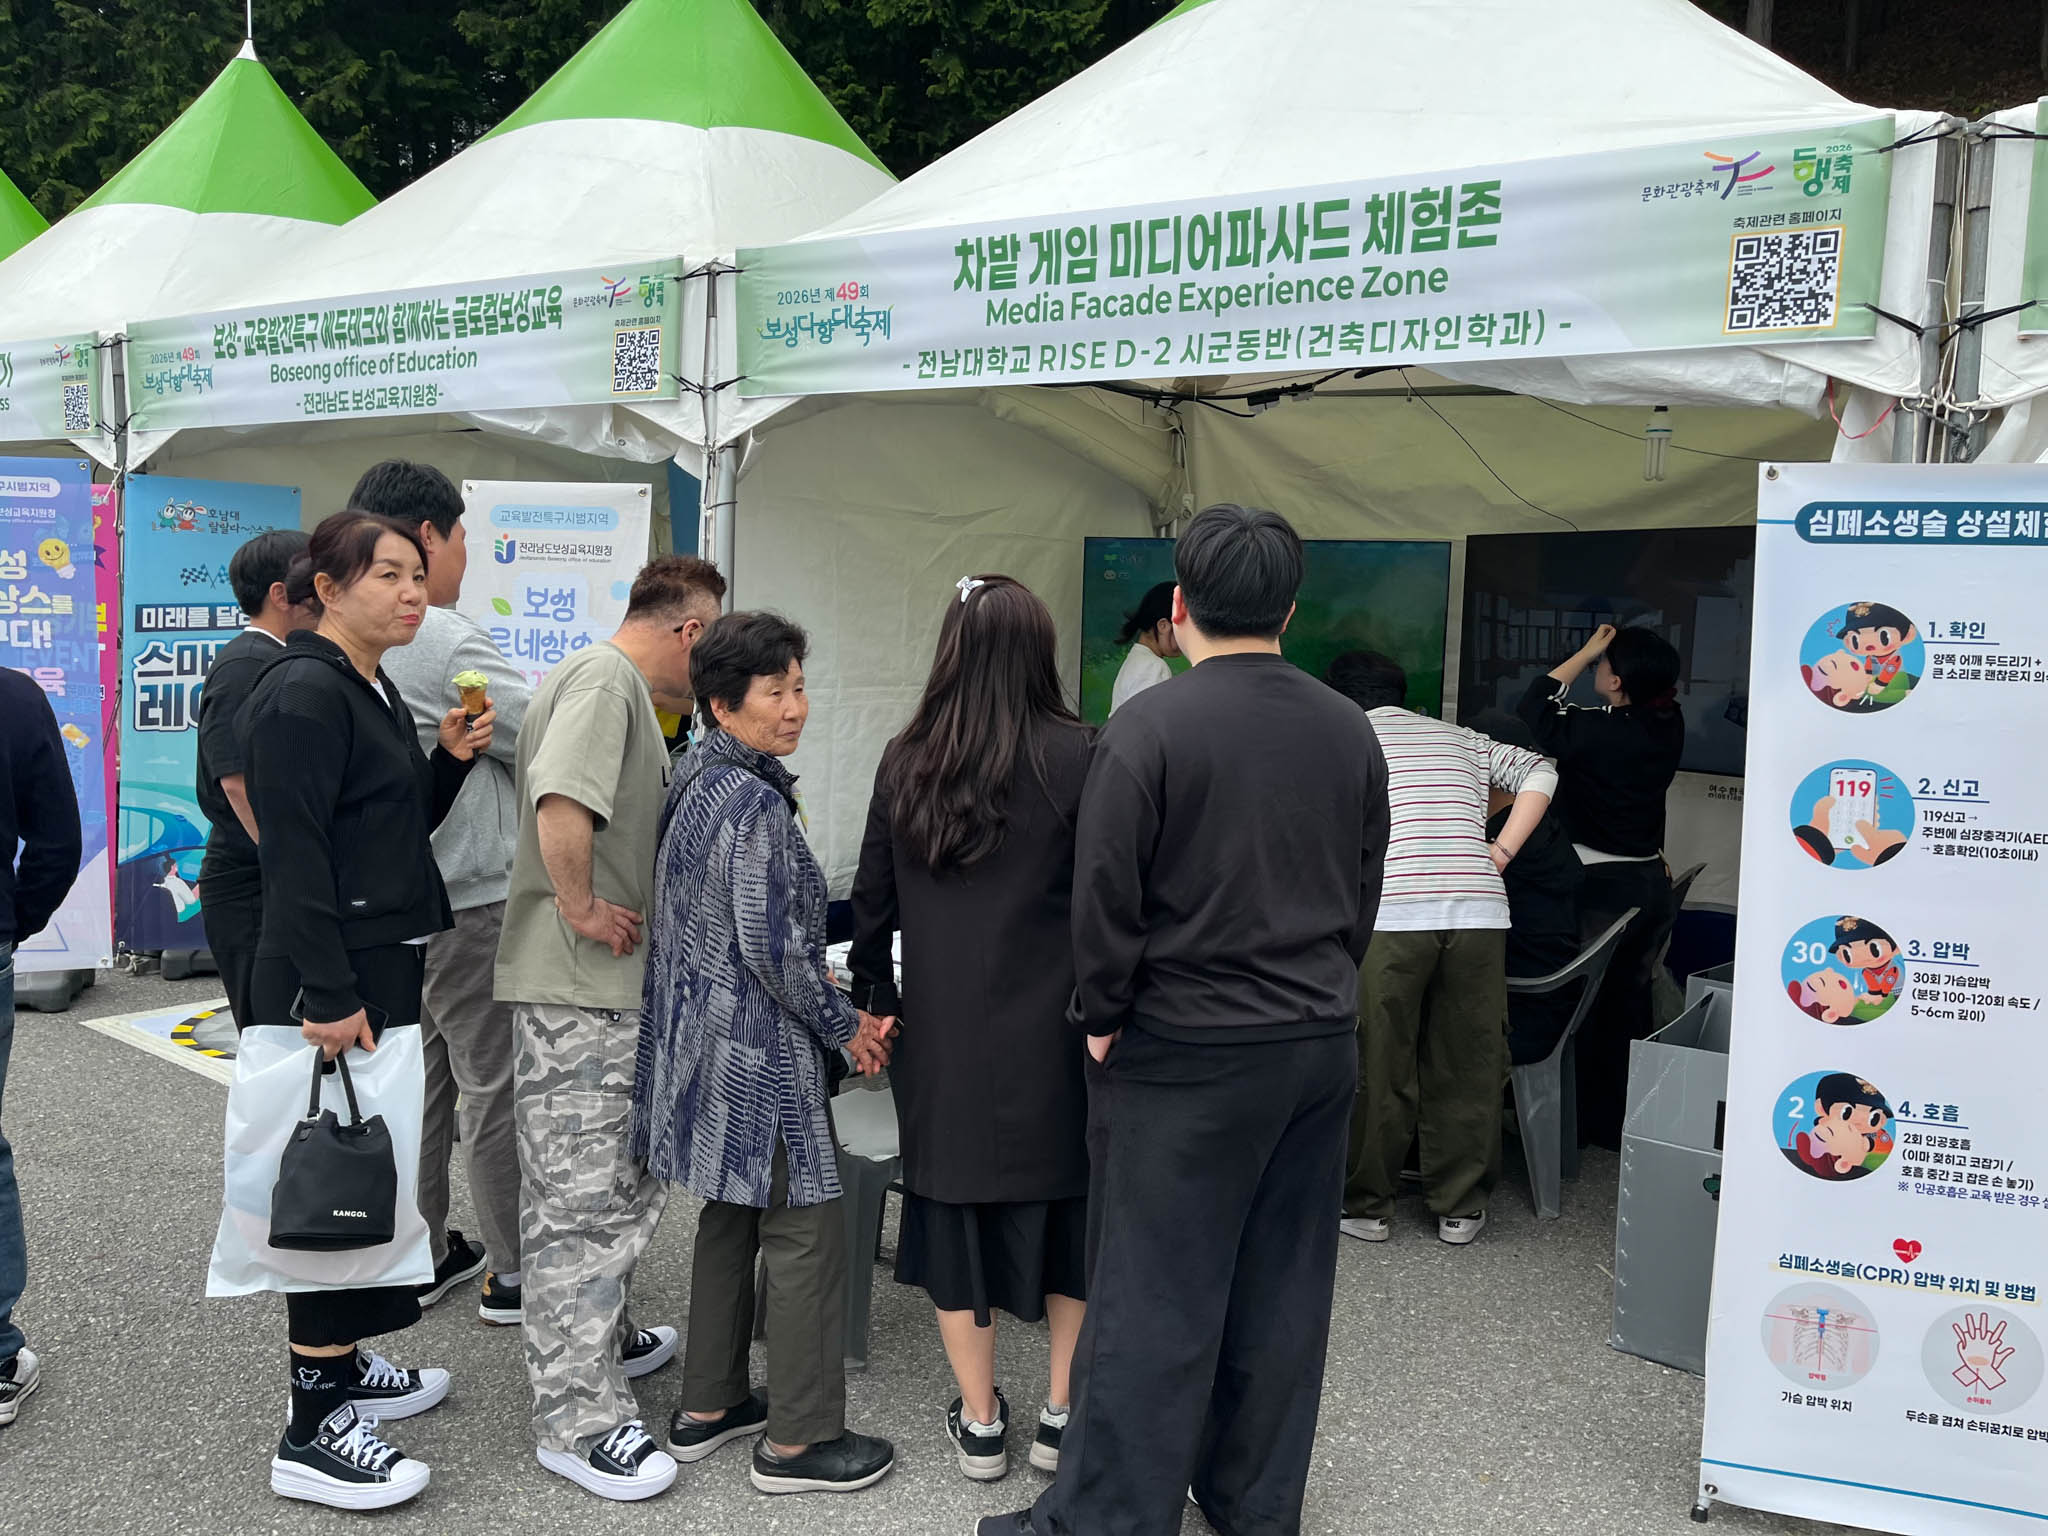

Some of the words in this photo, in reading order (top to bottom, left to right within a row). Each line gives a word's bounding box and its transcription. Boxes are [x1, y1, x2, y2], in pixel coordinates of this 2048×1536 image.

[1825, 144, 1852, 153] 2026
[1641, 179, 1720, 201] 문화관광축제
[1733, 213, 1785, 229] 축제관련
[1788, 208, 1842, 225] 홈페이지
[953, 236, 1021, 293] 차밭
[1029, 224, 1099, 285] 게임
[1110, 198, 1351, 279] 미디어파사드
[1362, 179, 1502, 255] 체험존
[777, 287, 821, 305] 2026년
[986, 292, 1065, 326] Media
[1070, 283, 1172, 320] Facade
[1179, 272, 1354, 317] Experience
[1361, 266, 1449, 299] Zone
[321, 304, 390, 350] 에듀테크와
[392, 298, 451, 345] 함께하는
[452, 285, 563, 339] 글로컬보성교육
[760, 304, 894, 348] 보성다향대축제
[917, 344, 1031, 379] 전남대학교
[1039, 340, 1106, 371] RISE
[1115, 338, 1173, 368] D-2
[1179, 308, 1546, 366] 시군동반(건축디자인학과)
[150, 351, 175, 364] 2026년
[271, 361, 331, 385] Boseong
[334, 355, 377, 378] office
[379, 353, 394, 373] of
[398, 346, 478, 374] Education
[304, 389, 350, 415] 전라남도
[208, 508, 240, 522] 호남대
[499, 510, 609, 525] 교육발전특구시범지역
[1809, 508, 1948, 538] 심폐소생술
[519, 541, 613, 558] 전라남도보성교육지원청
[142, 606, 209, 629] 미래를
[0, 619, 52, 649] 다!
[1928, 621, 1943, 639] 1.
[1949, 620, 1986, 640] 확인
[138, 643, 225, 678] 스마
[1933, 653, 1956, 666] 양쪽
[1960, 654, 1983, 666] 어깨
[1985, 655, 2032, 668] 두드리기
[1932, 667, 1944, 679] 큰
[1946, 668, 1982, 680] 소리로
[1984, 669, 2031, 682] 괜찮은지
[2033, 670, 2048, 683] 의
[1836, 779, 1872, 798] 119
[1918, 778, 1937, 795] 2.
[1943, 779, 1980, 797] 신고
[1923, 810, 1966, 823] 119신고
[1922, 826, 1957, 840] 주변에
[1932, 843, 2039, 862] 호흡확인(10초이내)
[1792, 940, 1827, 965] 30
[1908, 939, 1926, 957] 3.
[1933, 941, 1970, 961] 압박
[1912, 972, 1941, 985] 30회
[1911, 987, 1941, 1001] (분당
[1942, 990, 2005, 1007] 100-120회
[2007, 996, 2031, 1009] 속도
[1911, 1005, 1955, 1020] 5~6cm
[1957, 1009, 1986, 1022] 깊이)
[1787, 1095, 1805, 1119] 2
[1898, 1100, 1917, 1119] 4.
[1922, 1102, 1960, 1123] 호흡
[1903, 1132, 1923, 1146] 2회
[1925, 1135, 1972, 1151] 인공호흡
[1902, 1148, 1931, 1163] (이마
[1933, 1152, 1967, 1167] 젖히고
[1969, 1156, 2004, 1171] 코잡기
[1901, 1165, 1924, 1179] 호흡
[1927, 1168, 1950, 1181] 중간
[1952, 1171, 1964, 1183] 코
[1966, 1173, 1989, 1186] 잡은
[1991, 1175, 2003, 1188] 손
[1914, 1182, 1969, 1200] 인공호흡은
[1969, 1188, 1992, 1202] 교육
[1994, 1191, 2017, 1205] 받은
[2018, 1194, 2040, 1208] 경우
[332, 1209, 368, 1218] KANGOL
[1778, 1252, 1910, 1287] 심폐소생술(CPR)
[1913, 1271, 1946, 1291] 압박
[1949, 1275, 1980, 1295] 위치
[1984, 1279, 2001, 1297] 및
[2004, 1282, 2037, 1303] 방법
[1781, 1391, 1803, 1405] 가슴
[1806, 1395, 1828, 1408] 압박
[1830, 1398, 1852, 1412] 위치
[1905, 1409, 1939, 1425] 두손을
[1967, 1420, 2024, 1438] 손뒤꿈치로
